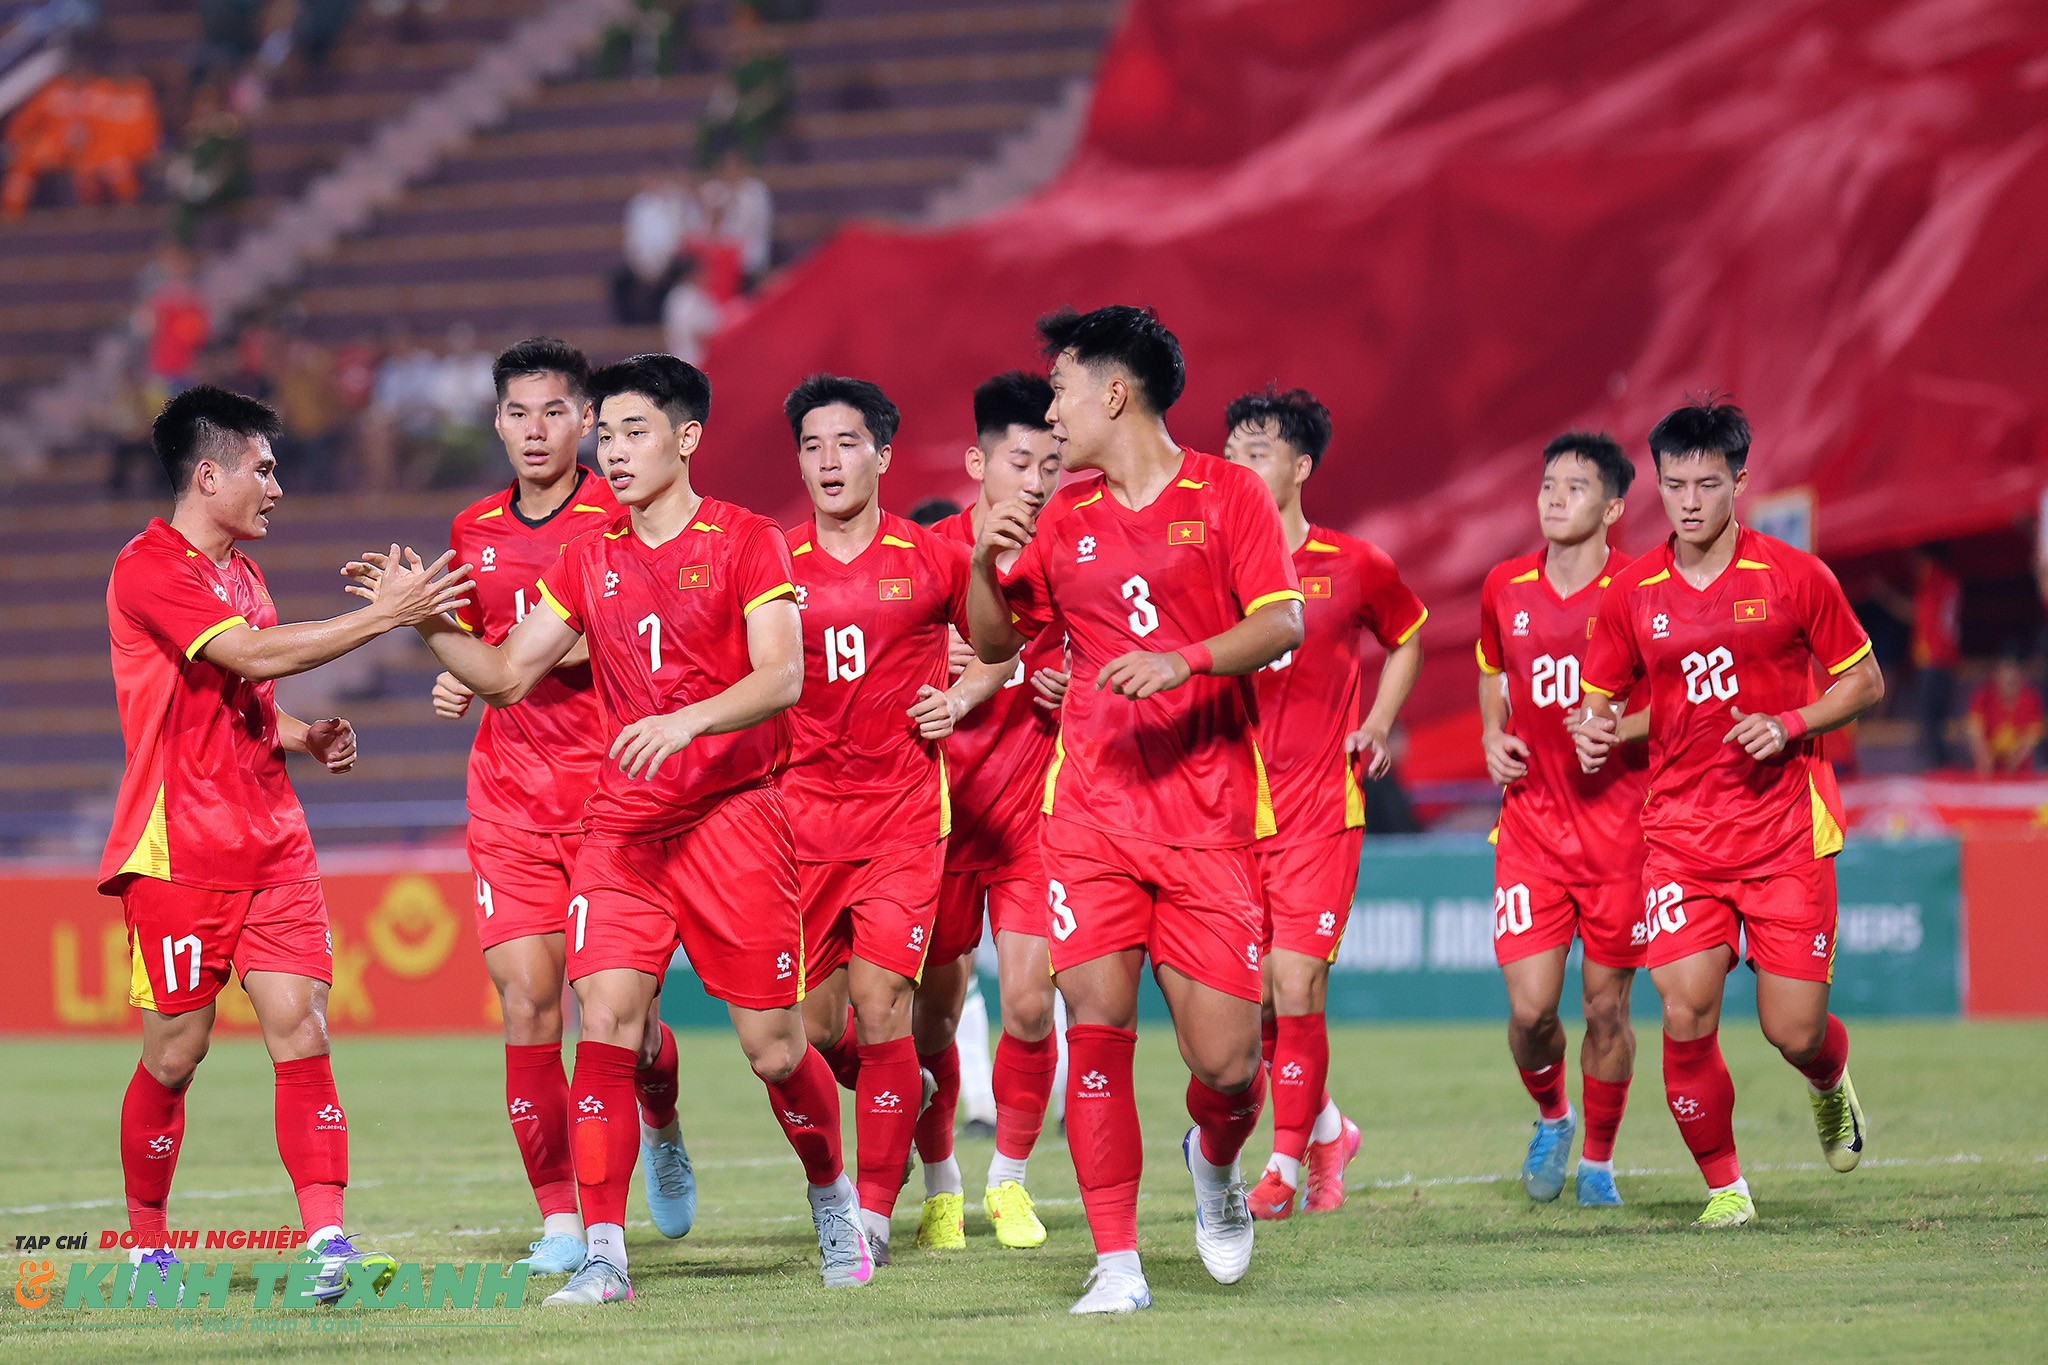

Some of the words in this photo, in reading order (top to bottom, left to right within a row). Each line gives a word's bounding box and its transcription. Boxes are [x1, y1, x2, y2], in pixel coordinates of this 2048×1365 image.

[1121, 574, 1160, 638] 3
[638, 612, 662, 674] 7
[824, 623, 867, 683] 19
[1531, 653, 1580, 709] 20
[1680, 645, 1740, 706] 22
[476, 873, 495, 919] 4
[567, 893, 589, 954] 7
[1048, 878, 1078, 942] 3
[162, 933, 203, 994] 17
